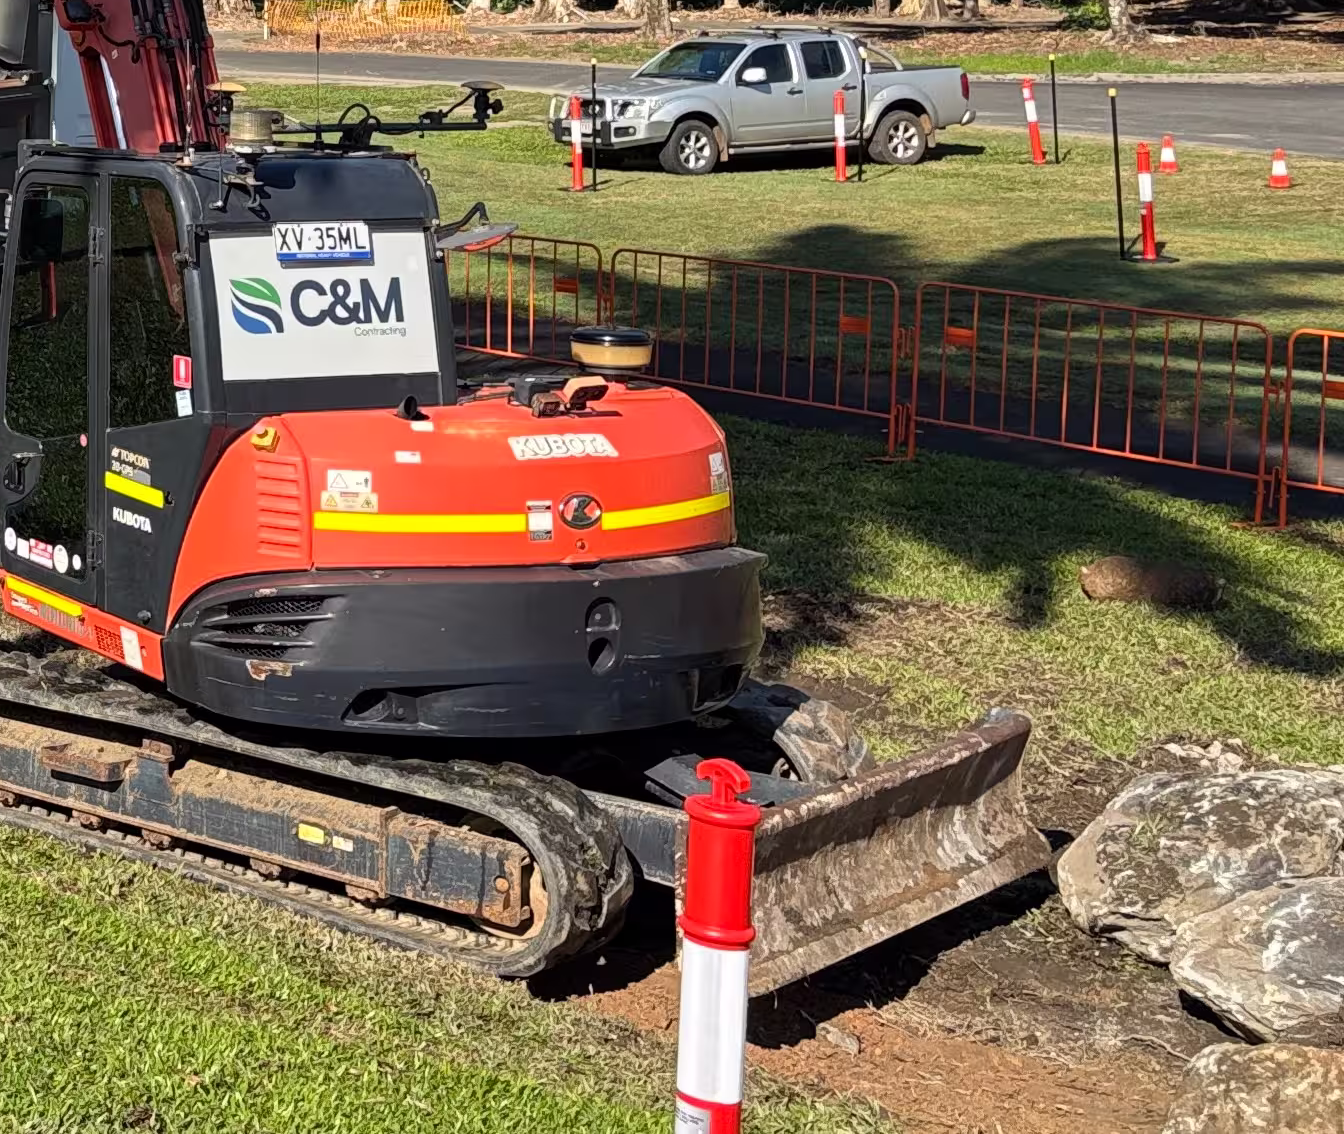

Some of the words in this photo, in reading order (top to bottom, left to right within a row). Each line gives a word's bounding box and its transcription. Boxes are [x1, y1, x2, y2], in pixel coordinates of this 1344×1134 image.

[277, 227, 304, 251] XV
[313, 226, 367, 251] 35ML
[290, 277, 405, 327] C&M
[354, 326, 407, 337] Contracting
[510, 434, 617, 460] KUBOTA
[113, 507, 152, 533] KUBOTA
